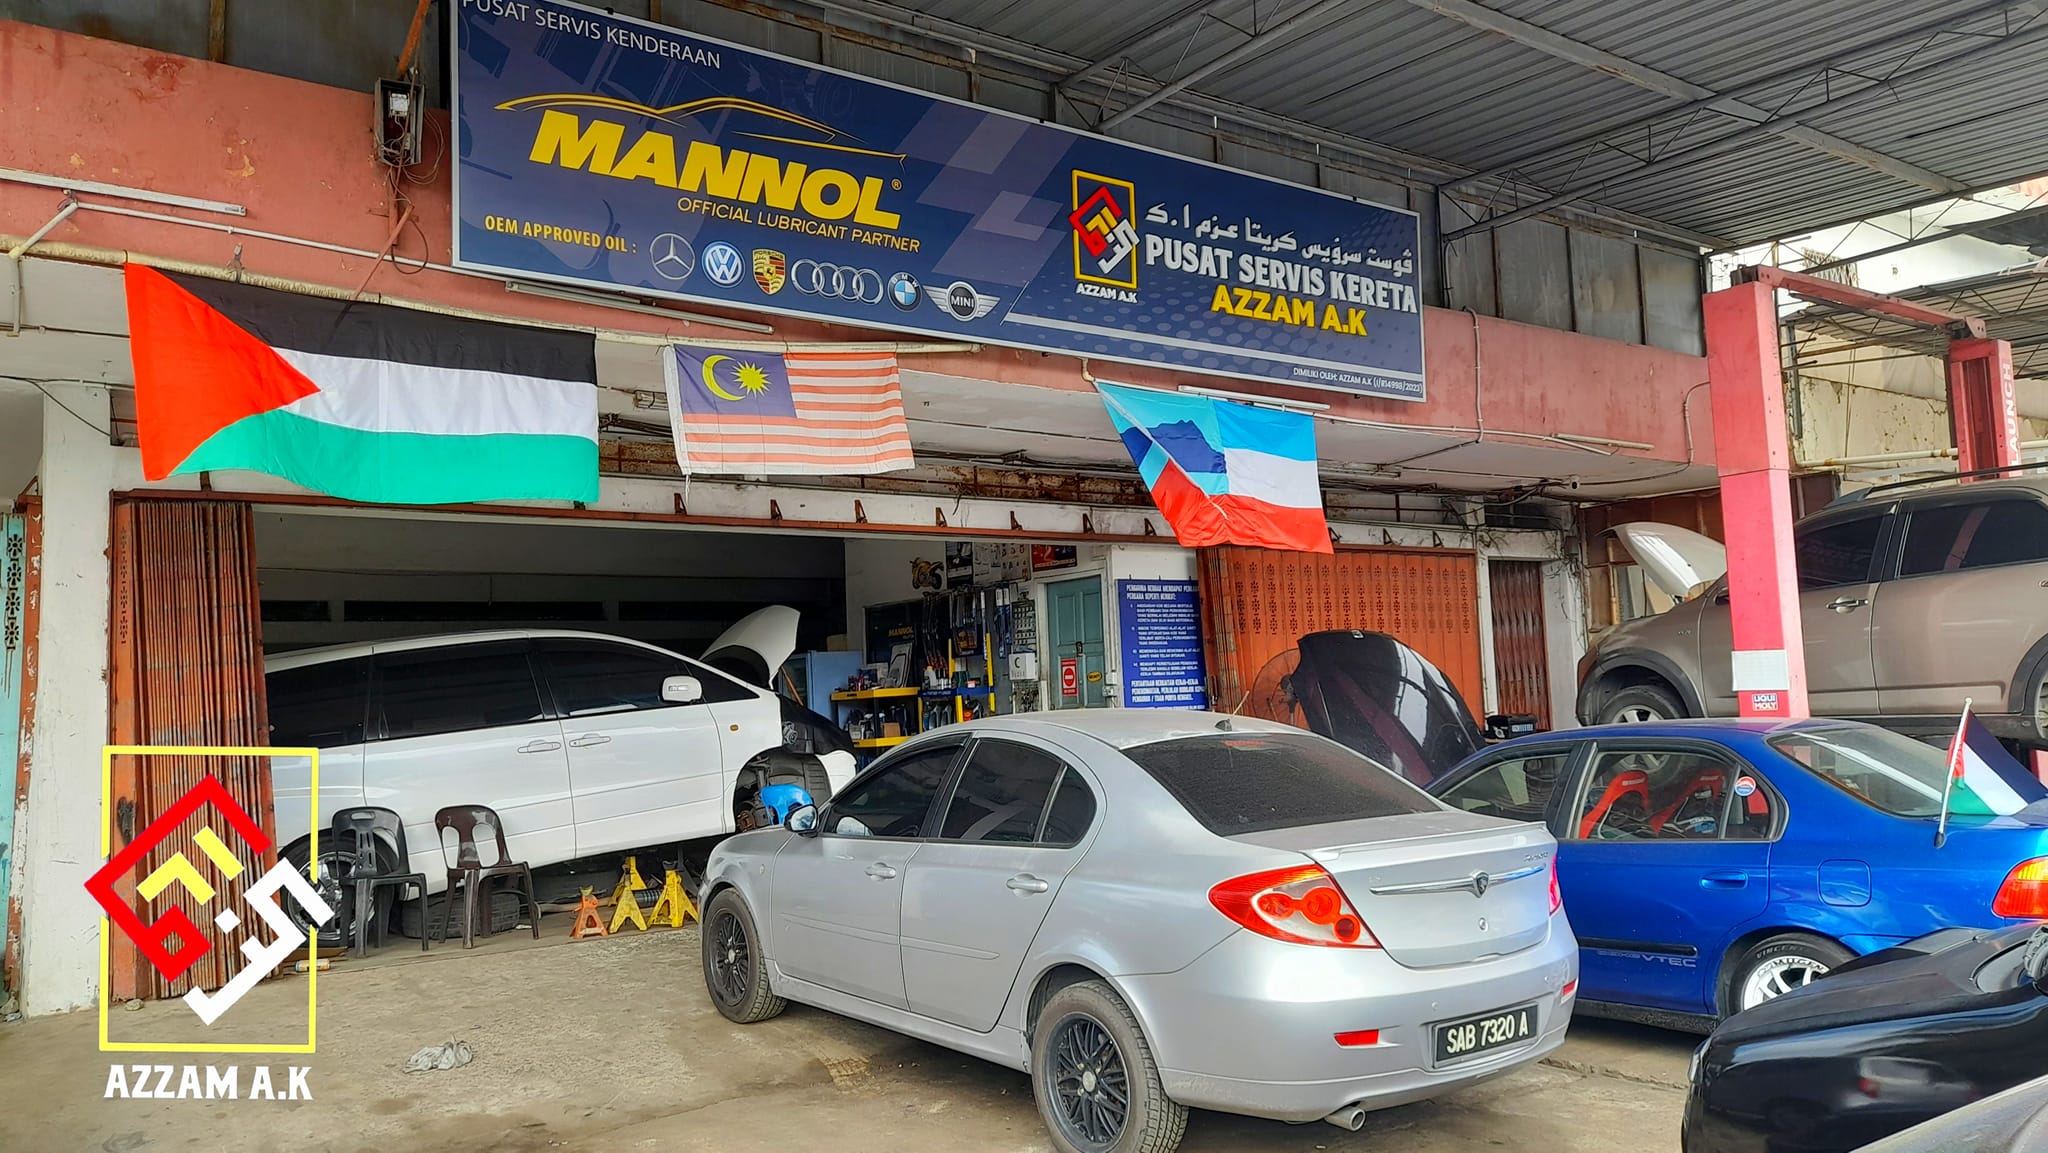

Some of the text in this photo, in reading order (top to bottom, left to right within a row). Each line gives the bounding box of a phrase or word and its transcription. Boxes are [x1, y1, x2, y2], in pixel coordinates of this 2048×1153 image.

[536, 8, 601, 40] SERVIS
[606, 26, 721, 69] KENDERAAN
[529, 109, 902, 230] MANNOL
[485, 215, 519, 234] OEM
[523, 221, 601, 247] APPROVED
[605, 235, 628, 252] OIL
[678, 196, 921, 253] OFFICIAL LUBRICANT PARTNER
[1076, 283, 1138, 303] AZZAM A.K
[1145, 234, 1418, 314] PUSAT SERVIS KERETA
[951, 295, 974, 308] MINI
[1210, 284, 1367, 336] AZZAM A.K
[1293, 367, 1318, 379] DIMILIKI
[1319, 371, 1337, 381] OLEH:
[1339, 374, 1361, 384] AZZAM
[1362, 377, 1372, 386] A.K
[2002, 363, 2019, 467] LAUNCH
[1754, 694, 1776, 702] LIQUI
[1754, 702, 1777, 710] MOLY
[1642, 953, 1696, 968] VTEC
[1446, 1013, 1529, 1054] SAB 7320 A
